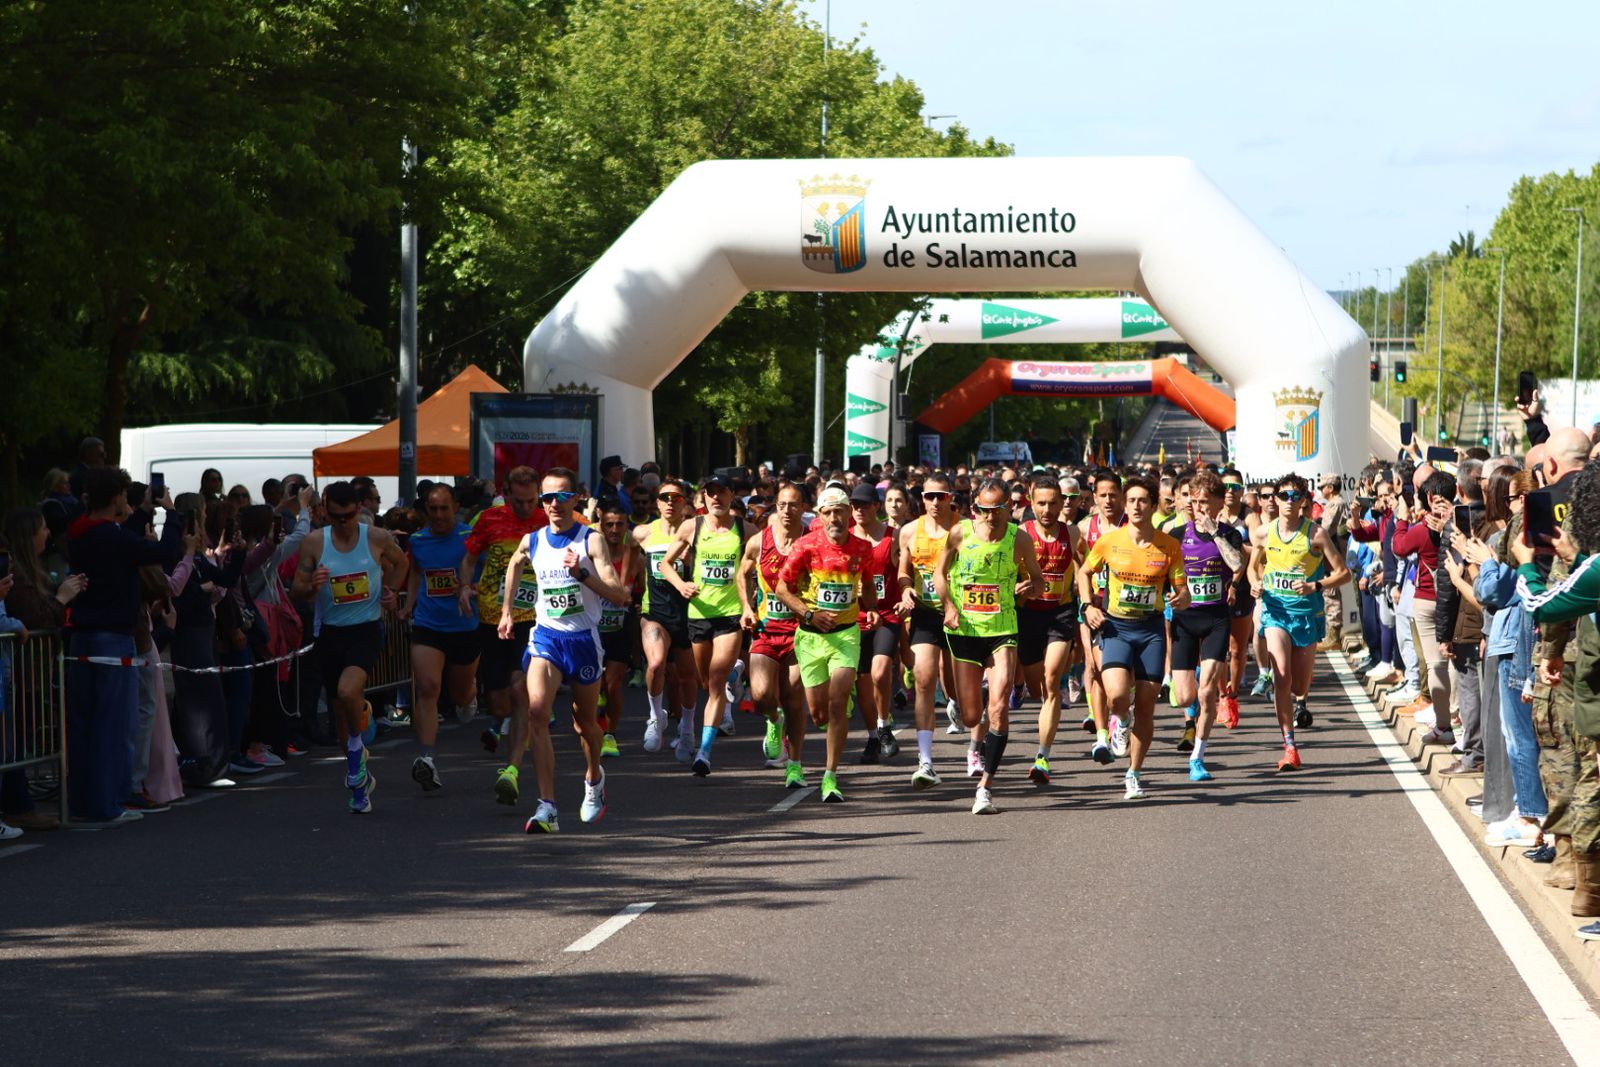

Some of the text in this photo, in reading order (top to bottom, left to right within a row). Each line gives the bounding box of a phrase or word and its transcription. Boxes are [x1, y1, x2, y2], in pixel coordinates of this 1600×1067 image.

[881, 205, 1076, 239] Ayuntamiento
[883, 243, 1077, 268] de Salamanca
[991, 313, 1012, 325] Corte
[1131, 313, 1152, 323] Corte
[706, 567, 729, 578] 708
[345, 582, 355, 594] 6
[431, 577, 452, 588] 182
[1193, 583, 1216, 595] 618
[550, 594, 578, 609] 695
[823, 590, 848, 603] 673
[968, 592, 995, 605] 516
